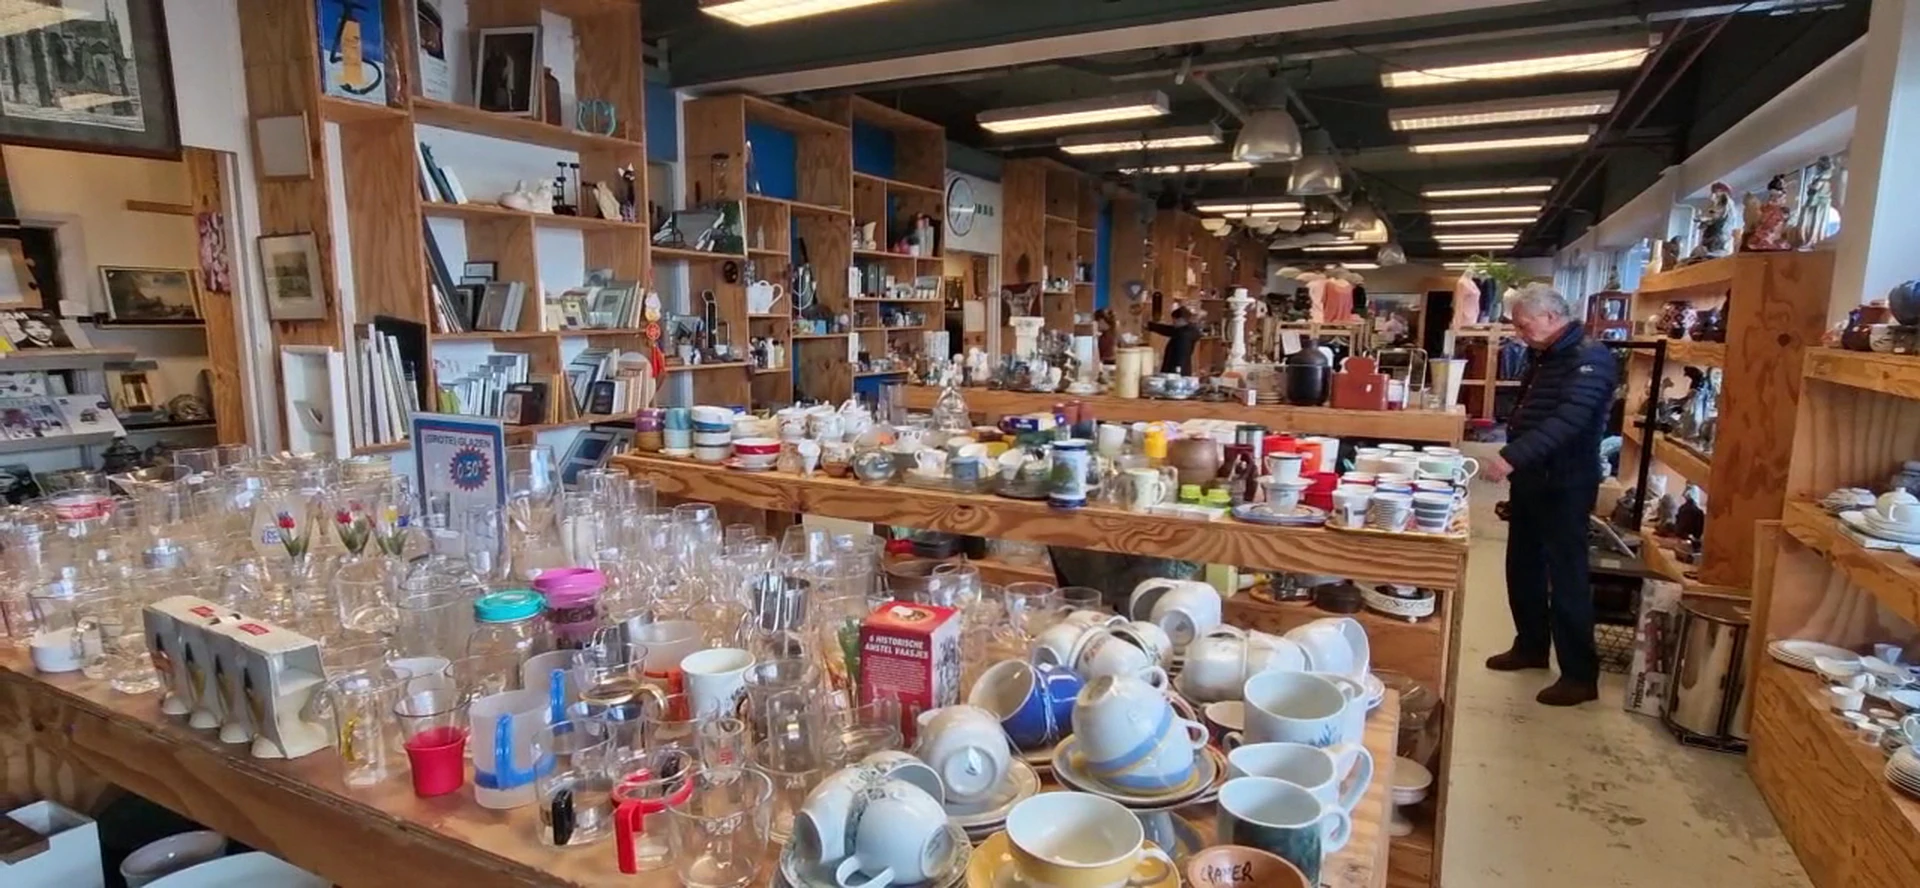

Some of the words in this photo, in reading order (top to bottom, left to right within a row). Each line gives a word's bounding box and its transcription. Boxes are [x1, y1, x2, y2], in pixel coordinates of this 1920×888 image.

[458, 437, 491, 448] GLAZEN
[868, 634, 875, 643] 6
[875, 635, 924, 649] HISTORISCHE
[864, 643, 892, 654] AMSTEL
[895, 646, 929, 660] VAASJES
[1632, 671, 1647, 709] TRISTAR
